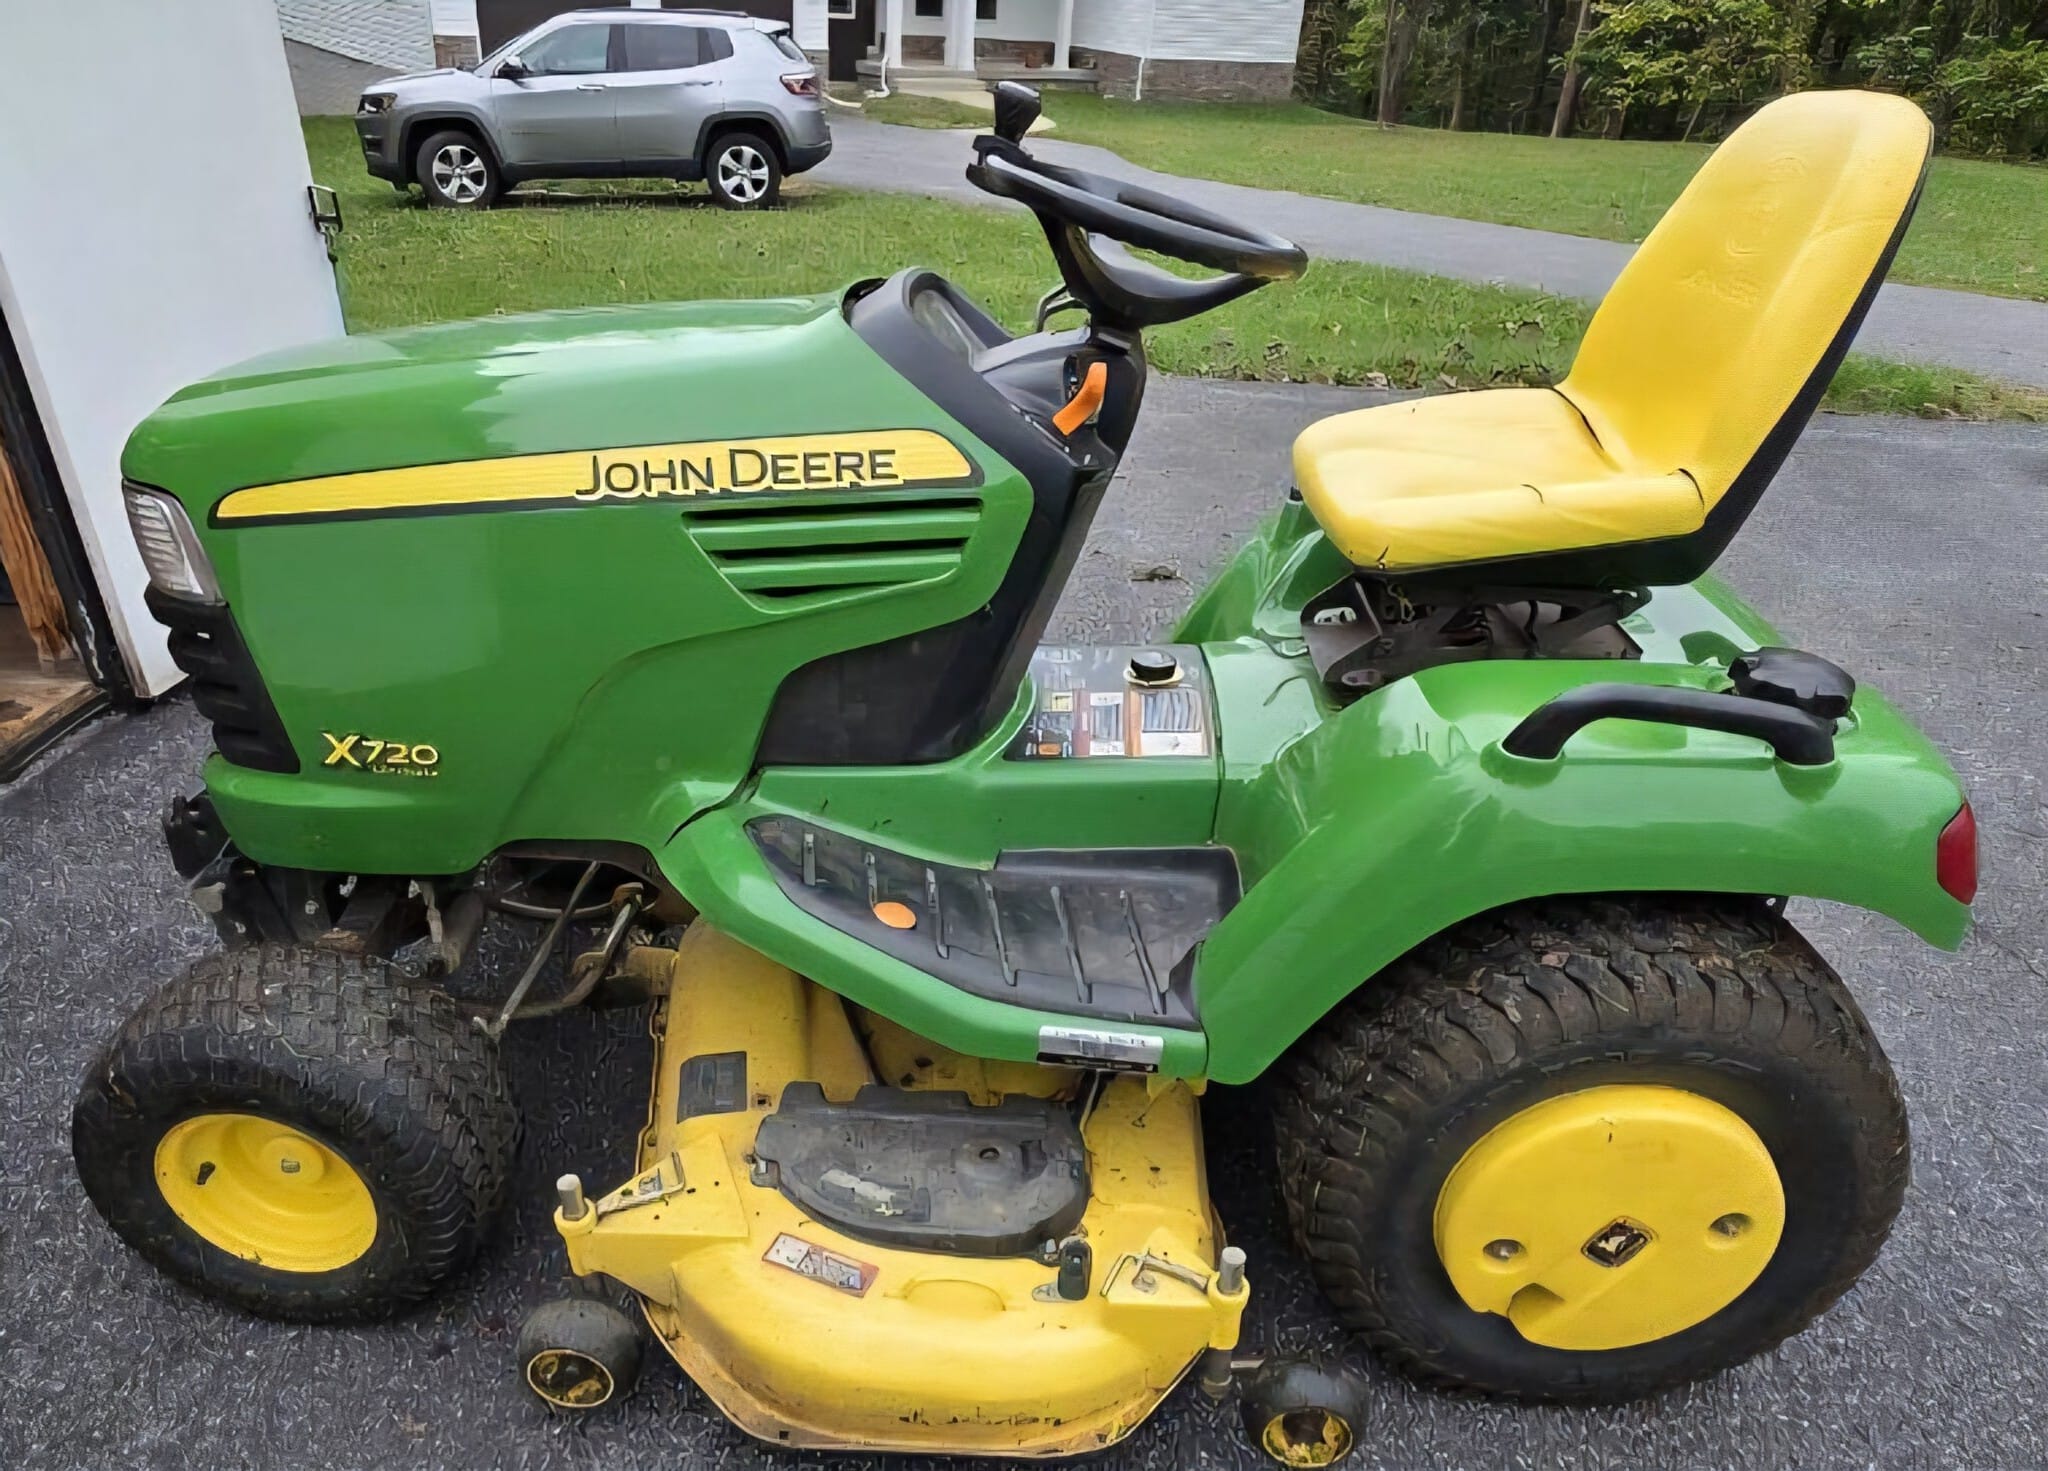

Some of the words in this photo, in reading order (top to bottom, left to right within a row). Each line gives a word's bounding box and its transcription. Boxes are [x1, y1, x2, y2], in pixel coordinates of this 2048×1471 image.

[576, 454, 715, 497] JOHN
[729, 448, 898, 488] DEERE
[321, 732, 439, 768] X720
